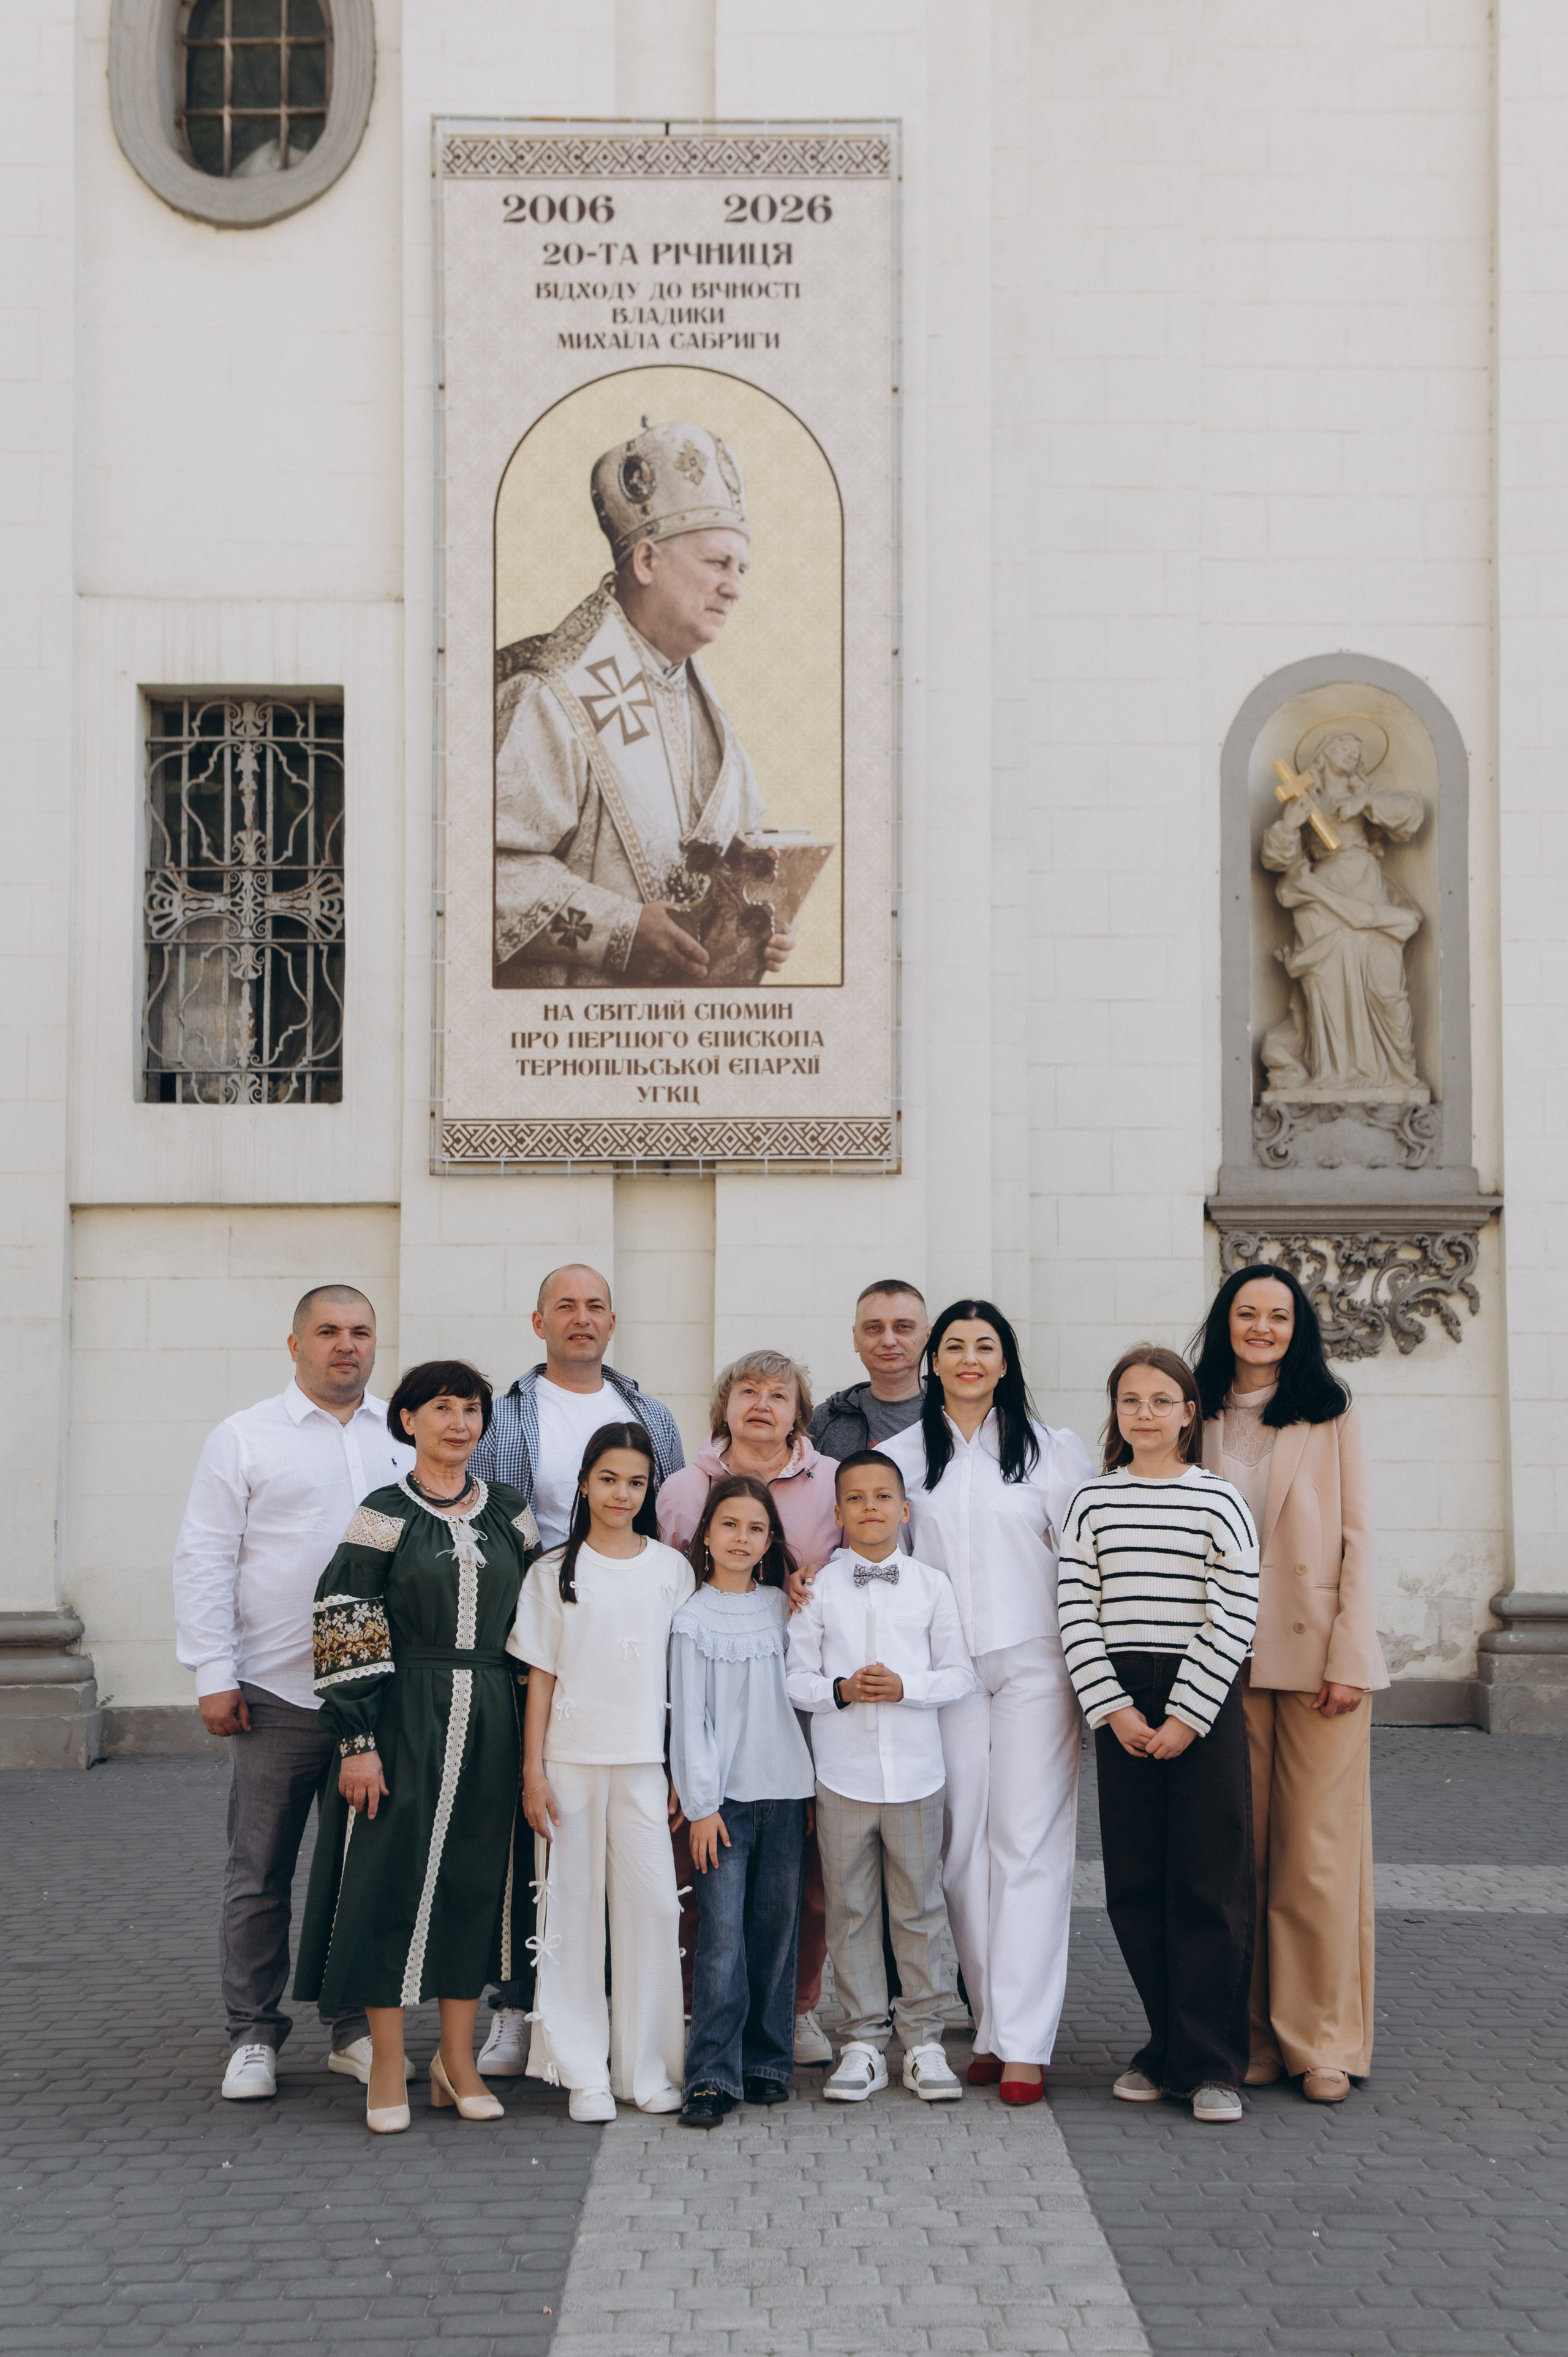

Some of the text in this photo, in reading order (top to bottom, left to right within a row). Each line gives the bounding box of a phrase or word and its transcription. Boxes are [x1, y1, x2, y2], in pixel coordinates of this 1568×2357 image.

[503, 194, 833, 224] 2006 2026
[543, 242, 793, 268] 20-ТА РІЧНИЦЯ
[535, 282, 800, 301] ВІДХОДУ ДО ВІЧНОСТІ
[612, 307, 725, 326] ВЛАДИКИ
[556, 329, 780, 350] МИХАЇЛА САБРИГИ
[543, 999, 793, 1022] НА СВІТЛИЙ СПОМИН
[511, 1030, 824, 1049] ПРО ПЕРШОГО ЄПИСКОПА
[516, 1055, 820, 1076] ТЕРНОПІЛЬСЬКОЇ ЄПАРХІЇ
[636, 1085, 700, 1106] УГКЦ
